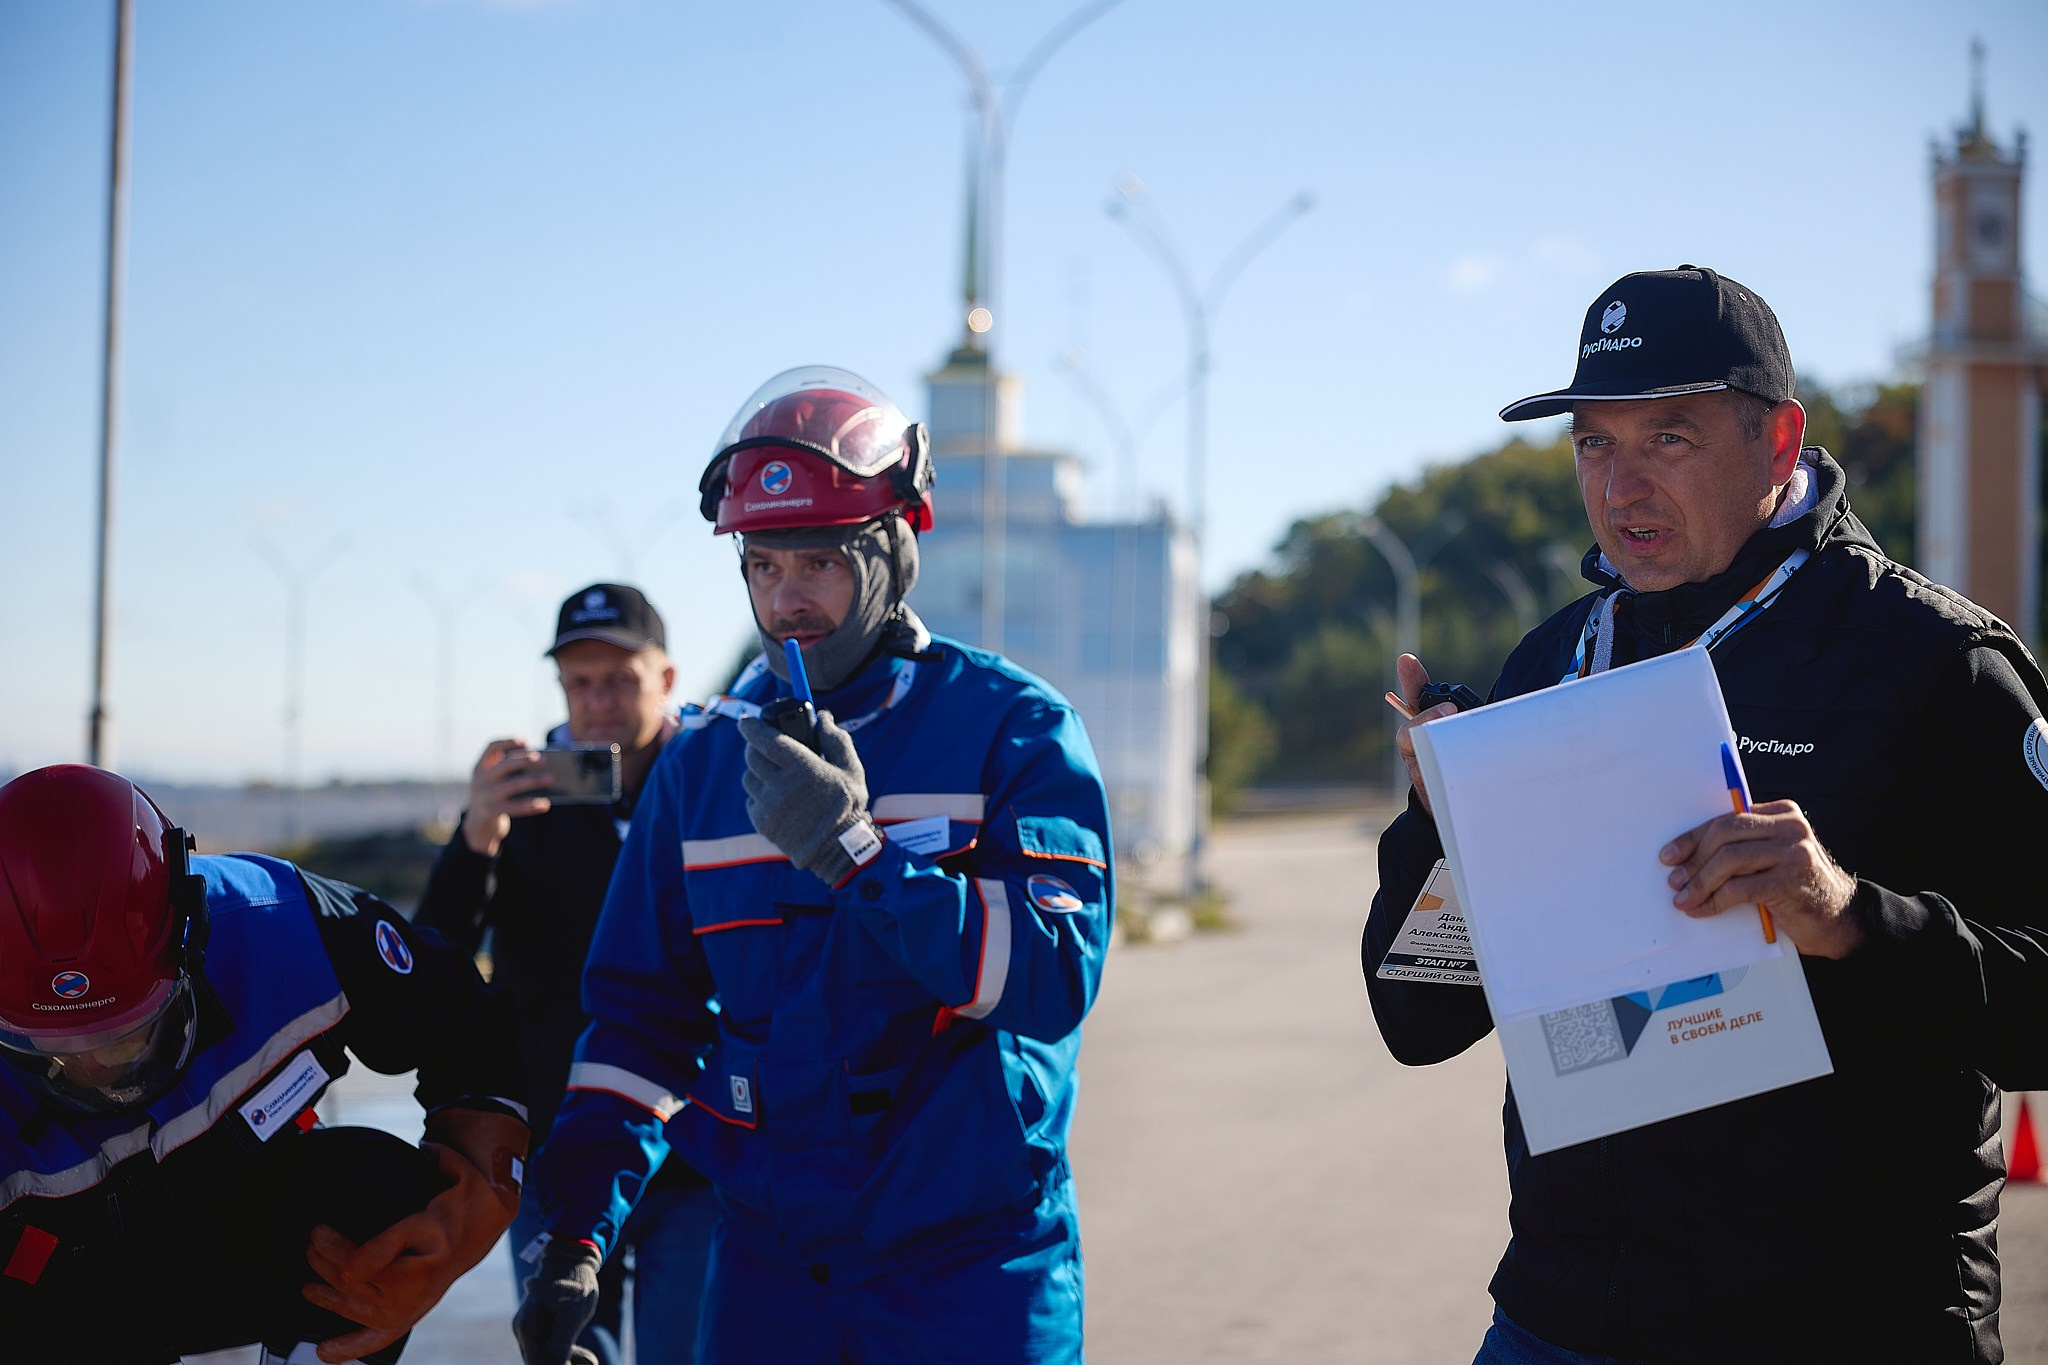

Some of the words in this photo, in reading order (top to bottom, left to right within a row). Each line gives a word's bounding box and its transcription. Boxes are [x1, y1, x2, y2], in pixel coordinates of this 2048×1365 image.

[1739, 736, 1814, 756] РусГидро
[1437, 913, 1466, 922] Дан
[1414, 957, 1447, 968] ЭТАП
[1446, 960, 1469, 969] №7
[1385, 969, 1442, 980] СТАРШИЙ
[1442, 973, 1480, 983] СУДЬЯ
[32, 996, 117, 1012] Сахалинэнерго
[1667, 1007, 1724, 1032] ЛУЧШИЕ
[1670, 1034, 1679, 1046] В
[1681, 1020, 1727, 1042] СВОЕМ
[1730, 1010, 1764, 1031] ДЕЛЕ
